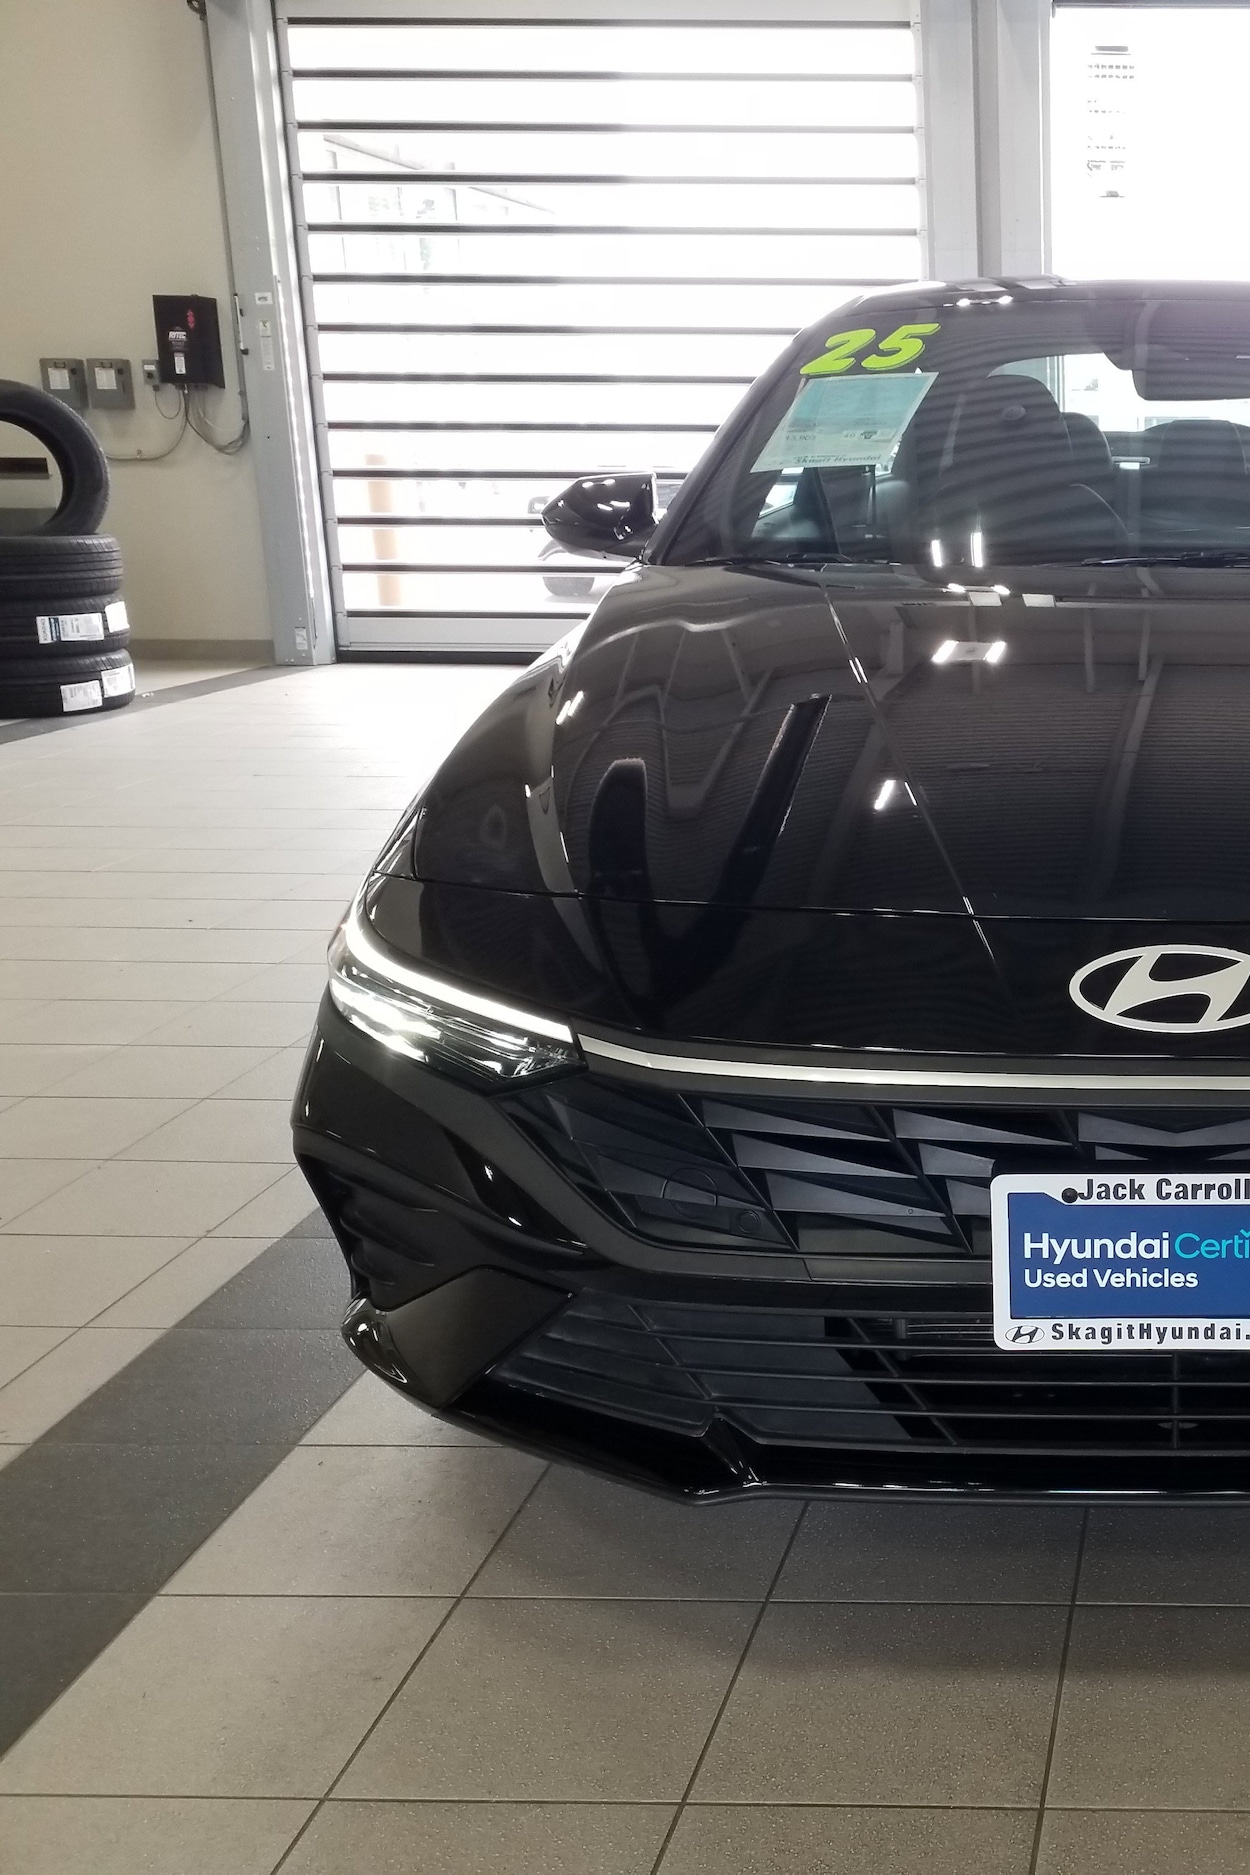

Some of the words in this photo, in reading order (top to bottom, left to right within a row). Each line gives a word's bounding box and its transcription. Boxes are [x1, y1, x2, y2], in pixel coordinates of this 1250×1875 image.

[800, 323, 941, 375] 25
[1078, 1178, 1146, 1201] Jack
[1023, 1232, 1170, 1264] Hyundai
[1024, 1269, 1088, 1288] Used
[1093, 1268, 1199, 1288] Vehicles
